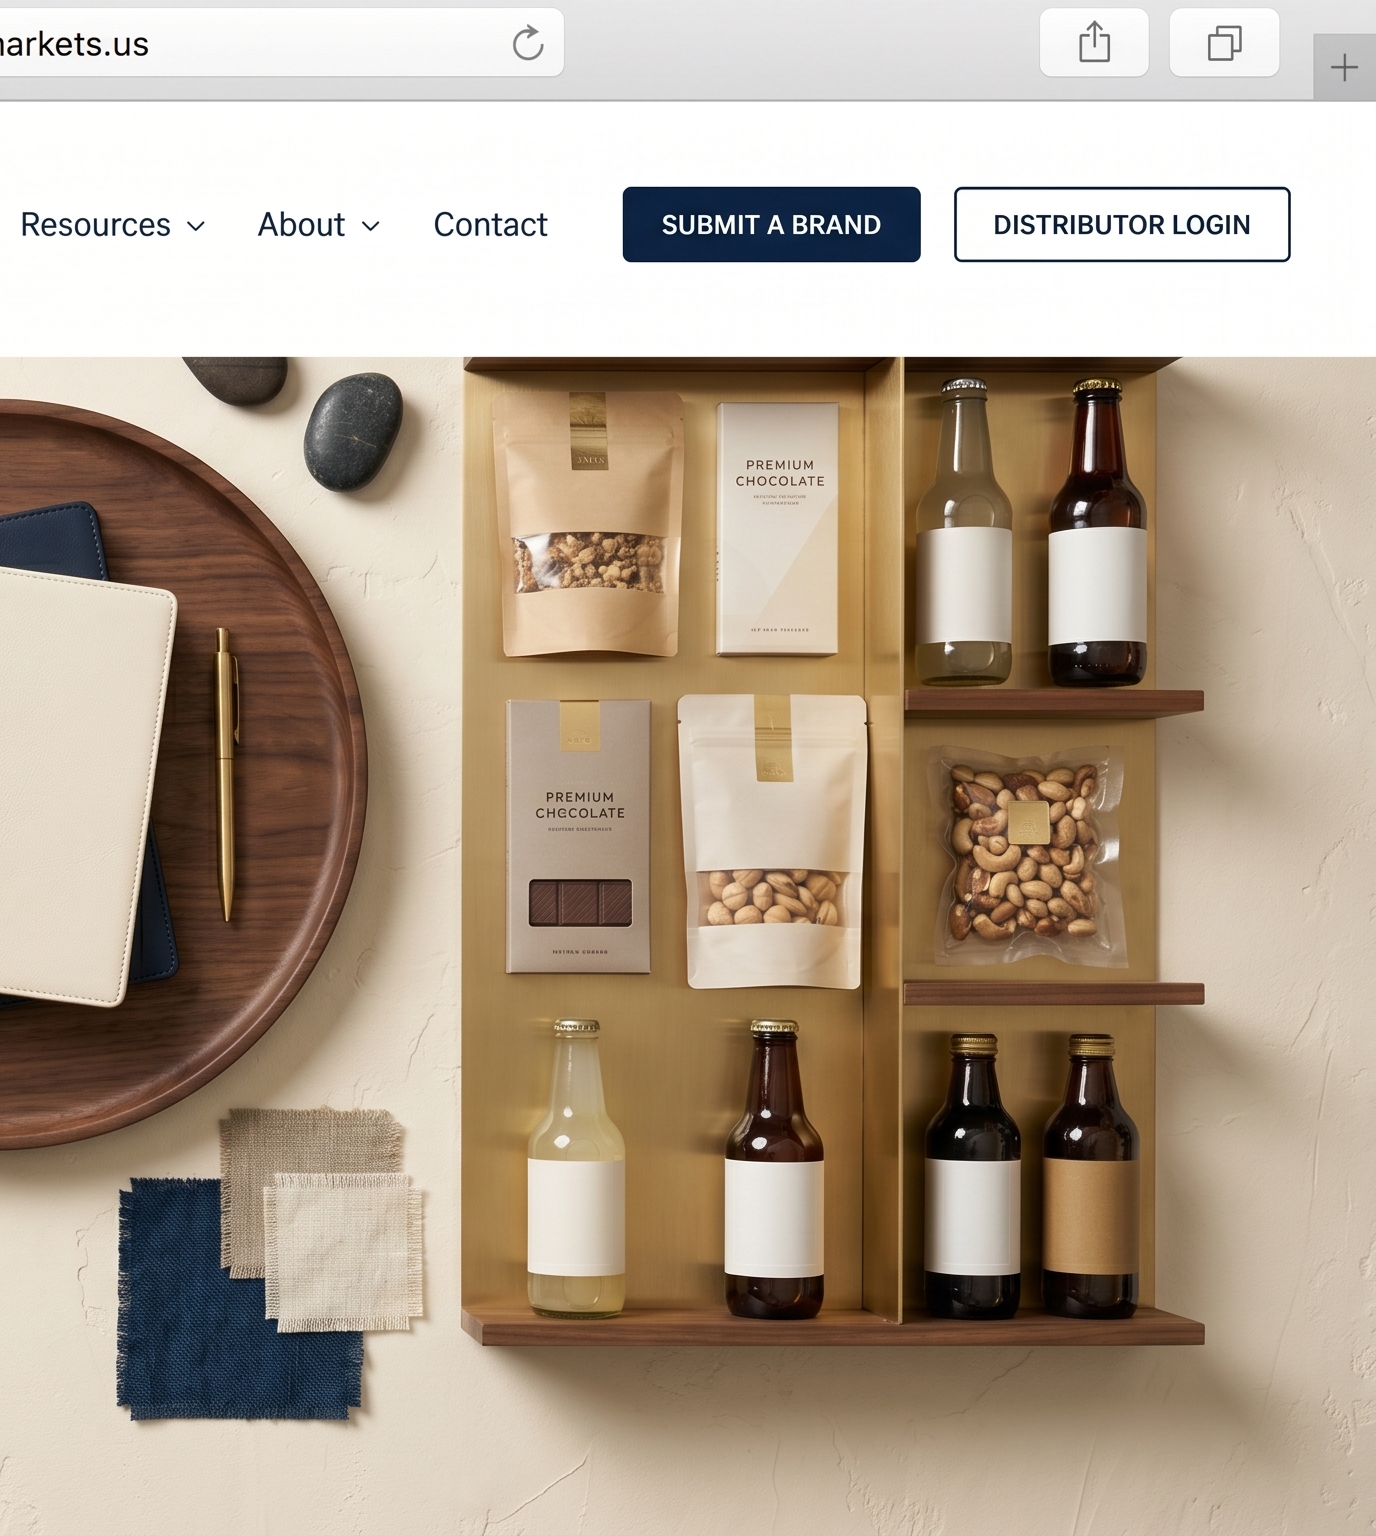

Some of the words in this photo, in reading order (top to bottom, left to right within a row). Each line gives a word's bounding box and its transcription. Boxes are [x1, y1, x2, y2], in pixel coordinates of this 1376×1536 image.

[21, 211, 171, 238] Resources
[257, 210, 346, 238] About
[434, 210, 549, 238] Contact
[661, 213, 761, 236] SUBMIT
[766, 214, 786, 235] A
[792, 214, 882, 235] BRAND
[994, 213, 1166, 236] DISTRIBUTOR
[1172, 213, 1250, 236] LOGIN
[746, 459, 814, 471] PREMIUM
[735, 475, 825, 487] CHOCOLATE
[546, 791, 614, 803] PREMIUM
